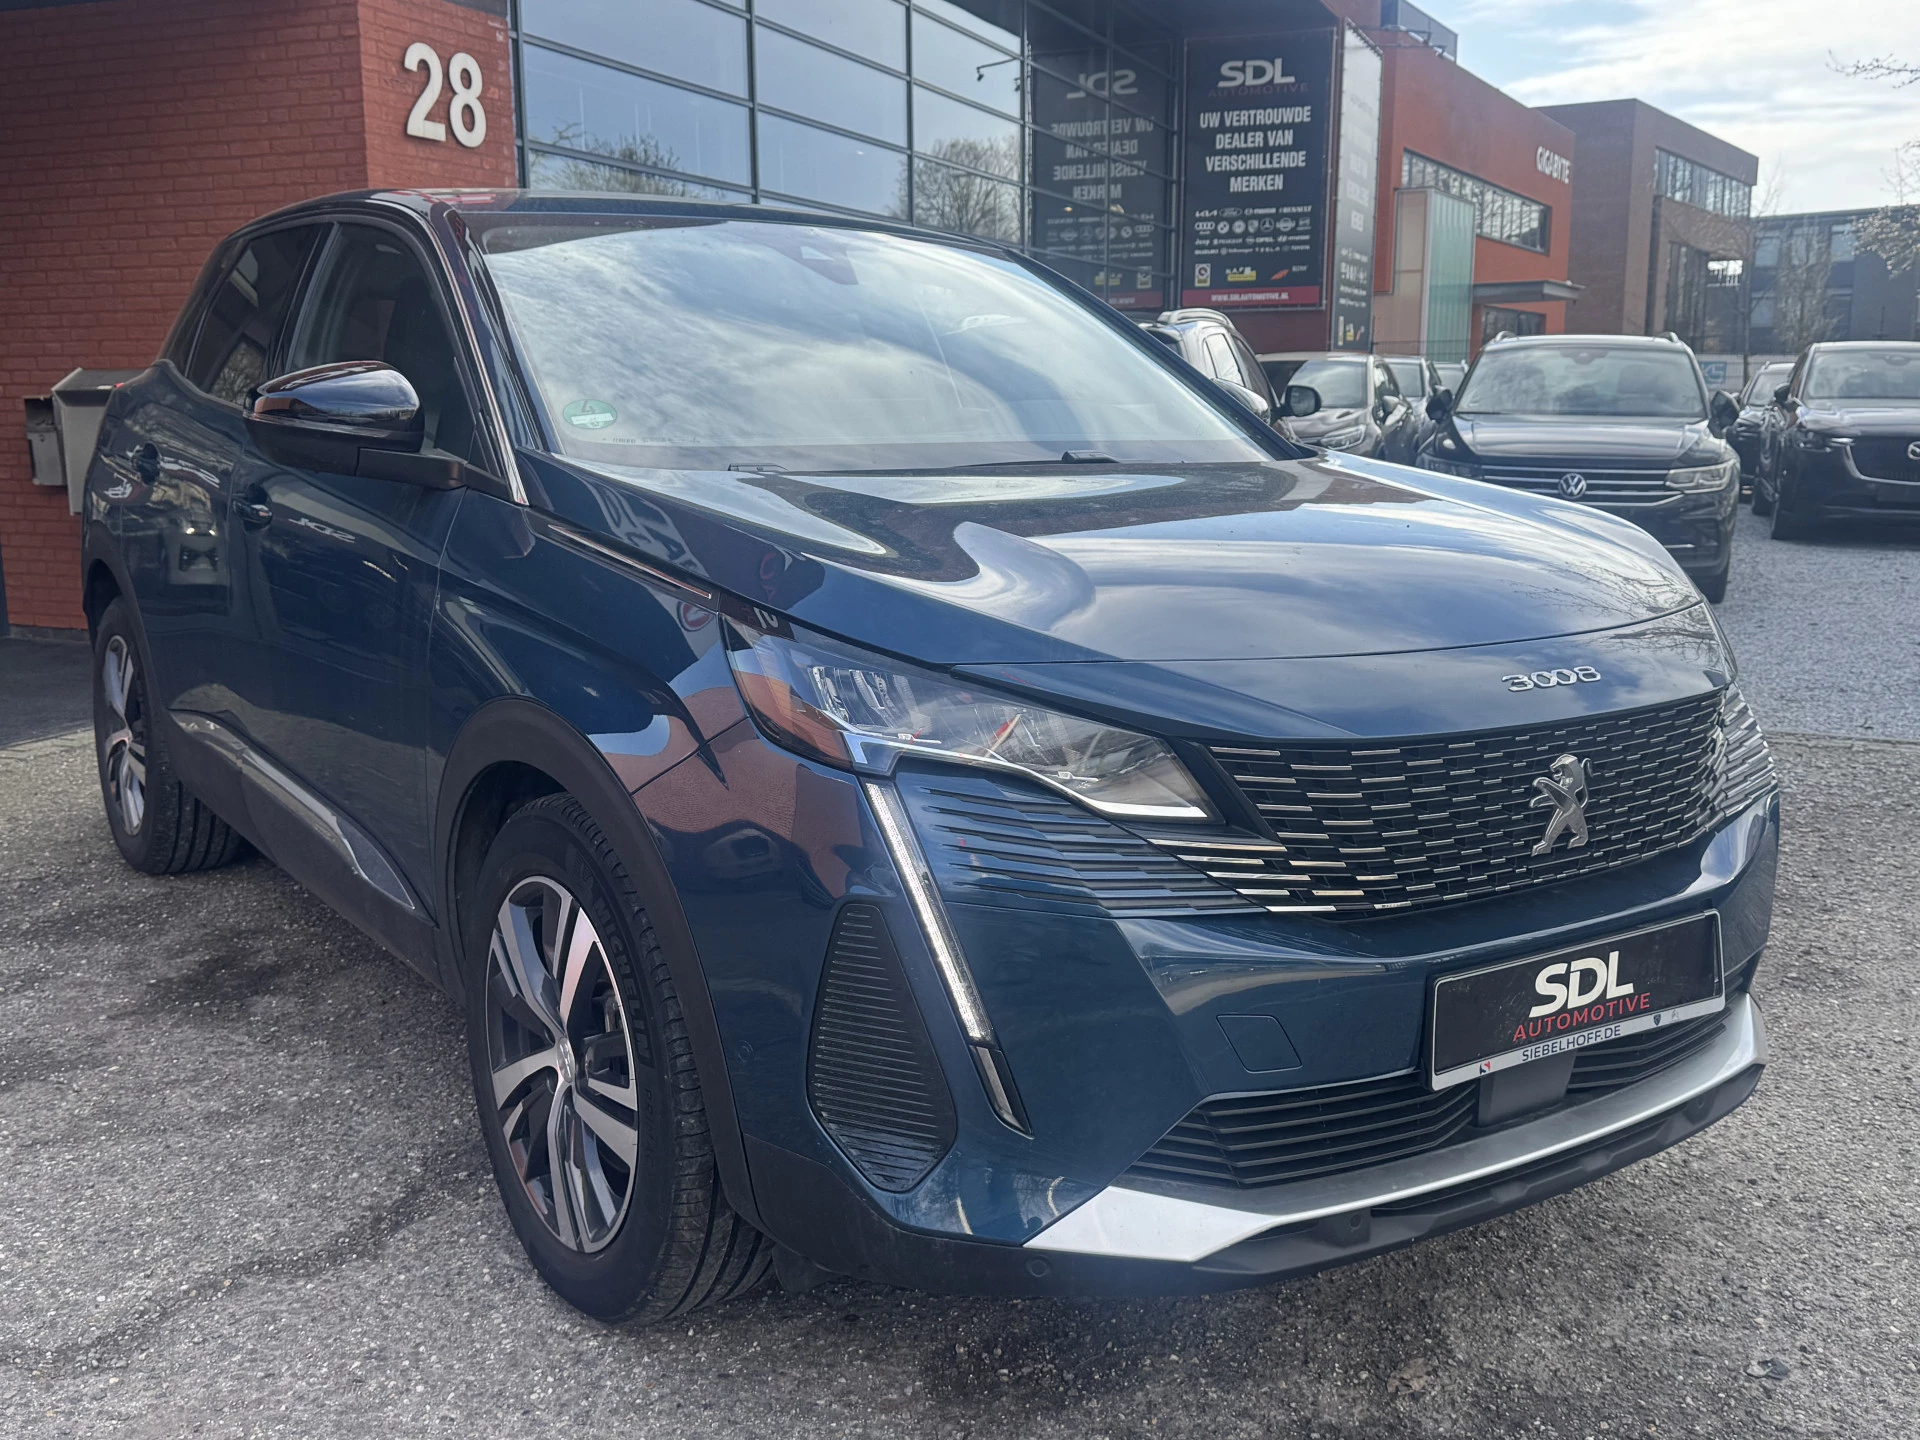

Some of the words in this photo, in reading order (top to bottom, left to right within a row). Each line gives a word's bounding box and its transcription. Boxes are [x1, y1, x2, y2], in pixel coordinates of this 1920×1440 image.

[1217, 57, 1296, 88] SDL
[404, 42, 487, 148] 28
[1207, 82, 1309, 98] AUTOMOTIVE
[1199, 111, 1221, 128] UW
[1224, 105, 1312, 127] VERTROUWDE
[1215, 131, 1264, 150] DEALER
[1267, 129, 1294, 147] VAN
[1205, 150, 1306, 172] VERSCHILLENDE
[1229, 174, 1284, 192] MERKEN
[1502, 665, 1601, 692] 3008
[594, 897, 650, 1065] MICHELIN
[1528, 950, 1635, 1018] SDL
[1512, 992, 1650, 1042] AUTOMOTIVE
[1522, 1025, 1621, 1062] SIEBELHOFF.DE
